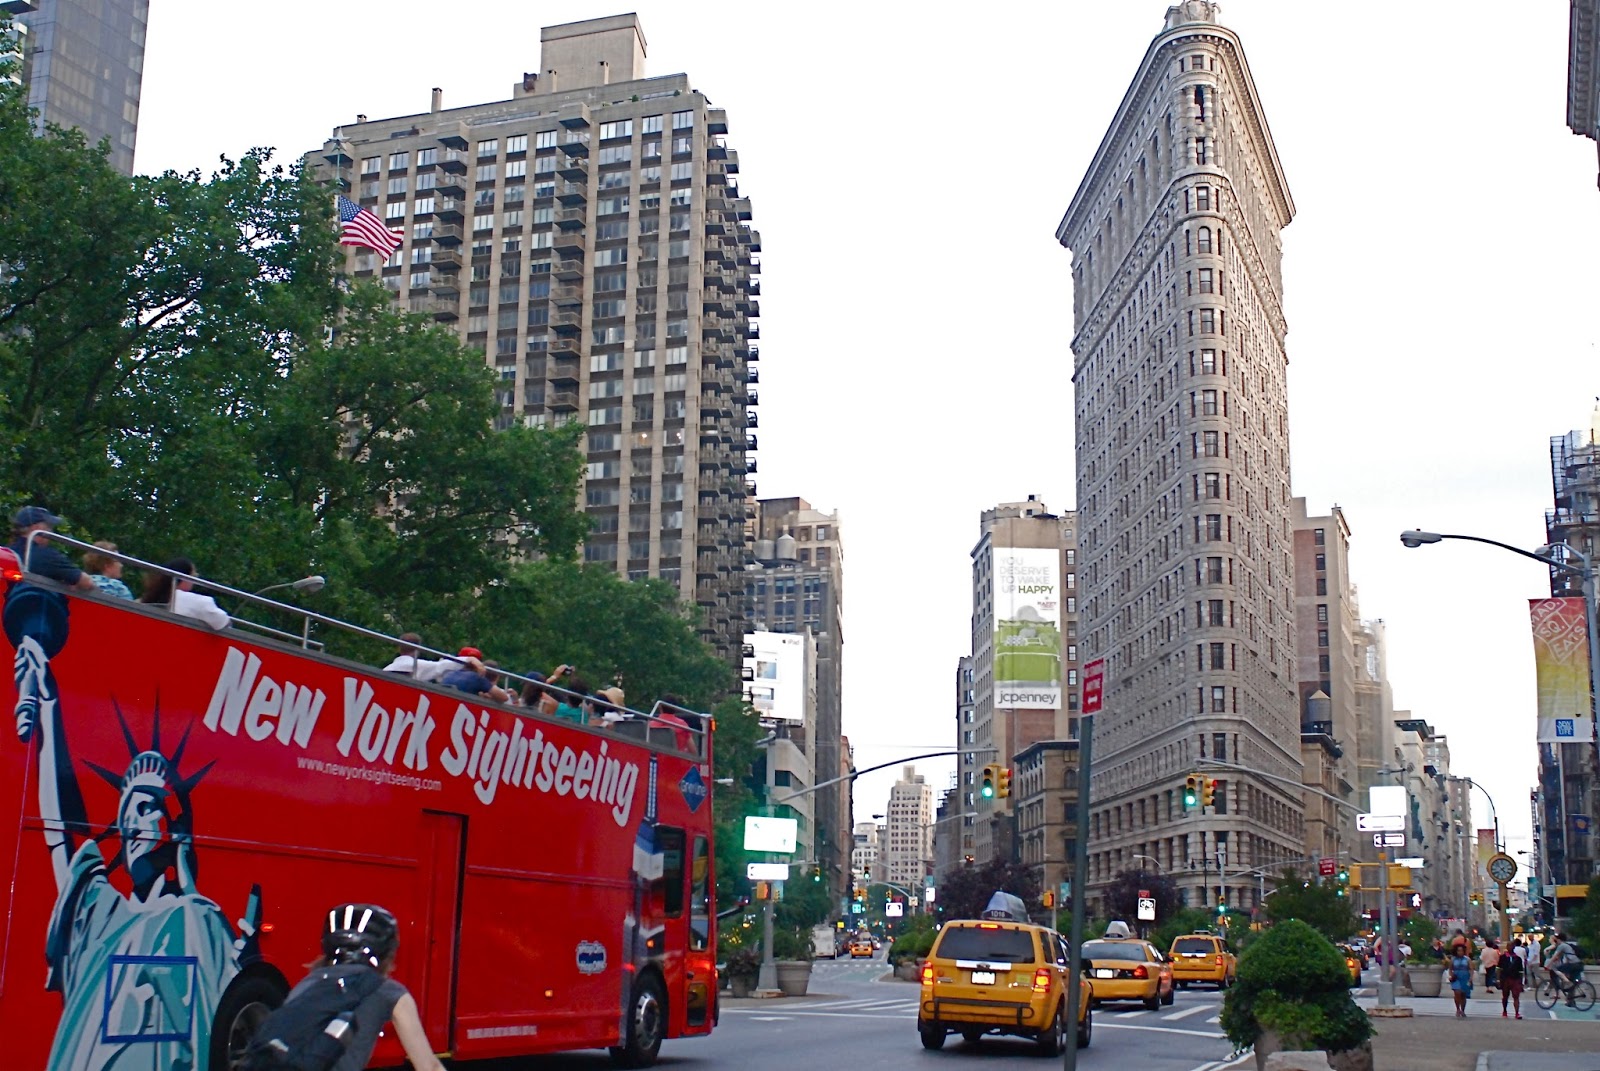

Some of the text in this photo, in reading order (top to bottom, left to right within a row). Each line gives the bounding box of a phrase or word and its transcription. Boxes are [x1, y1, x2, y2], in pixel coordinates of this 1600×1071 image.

[1000, 556, 1024, 566] YOU
[1000, 566, 1050, 575] DESERVE
[1000, 575, 1050, 585] TO WAKE
[1001, 585, 1054, 594] UP HAPPY
[1540, 620, 1565, 638] SQ.
[1553, 626, 1586, 659] EATS
[998, 691, 1057, 705] jcpenney
[203, 645, 640, 828] New York Sightseeing
[297, 756, 442, 791] www.newyorksightseeing.com
